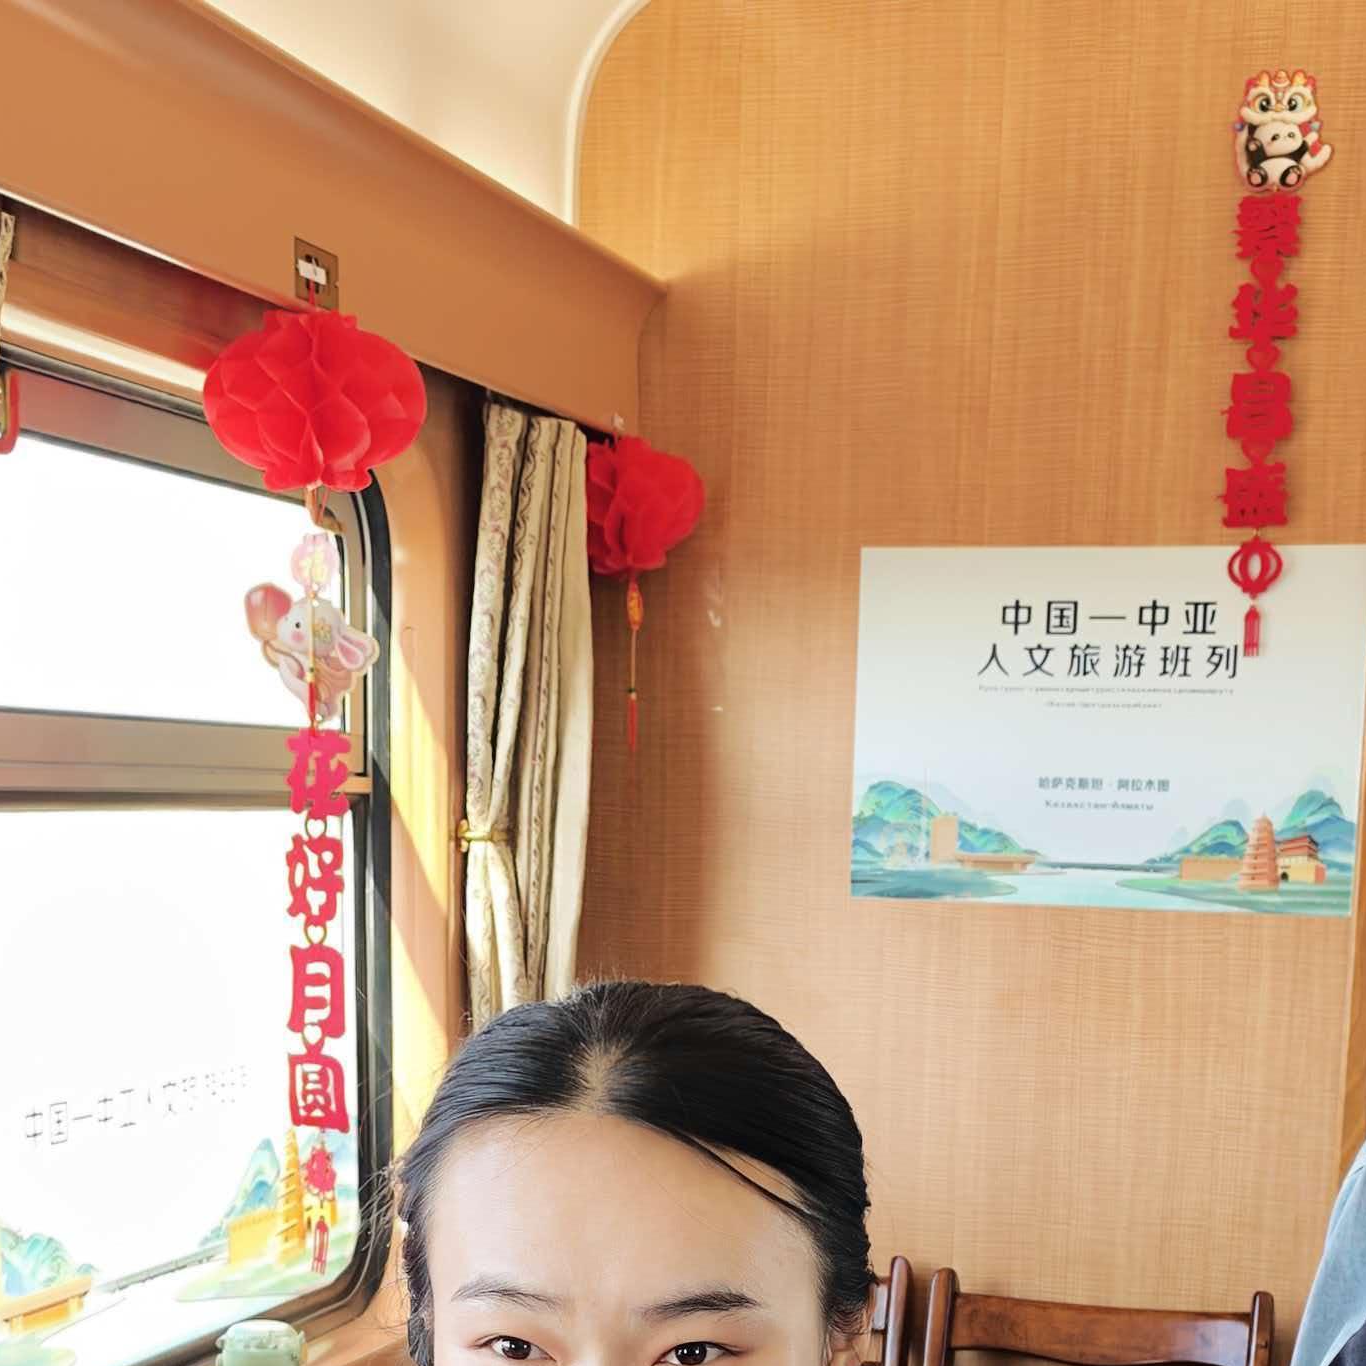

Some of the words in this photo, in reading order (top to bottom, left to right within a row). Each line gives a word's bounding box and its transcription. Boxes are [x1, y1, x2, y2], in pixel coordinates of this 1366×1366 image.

[1001, 599, 1217, 635] 中国—中亚
[977, 643, 1238, 679] 人文旅游班列
[285, 729, 350, 1134] 花好月圆
